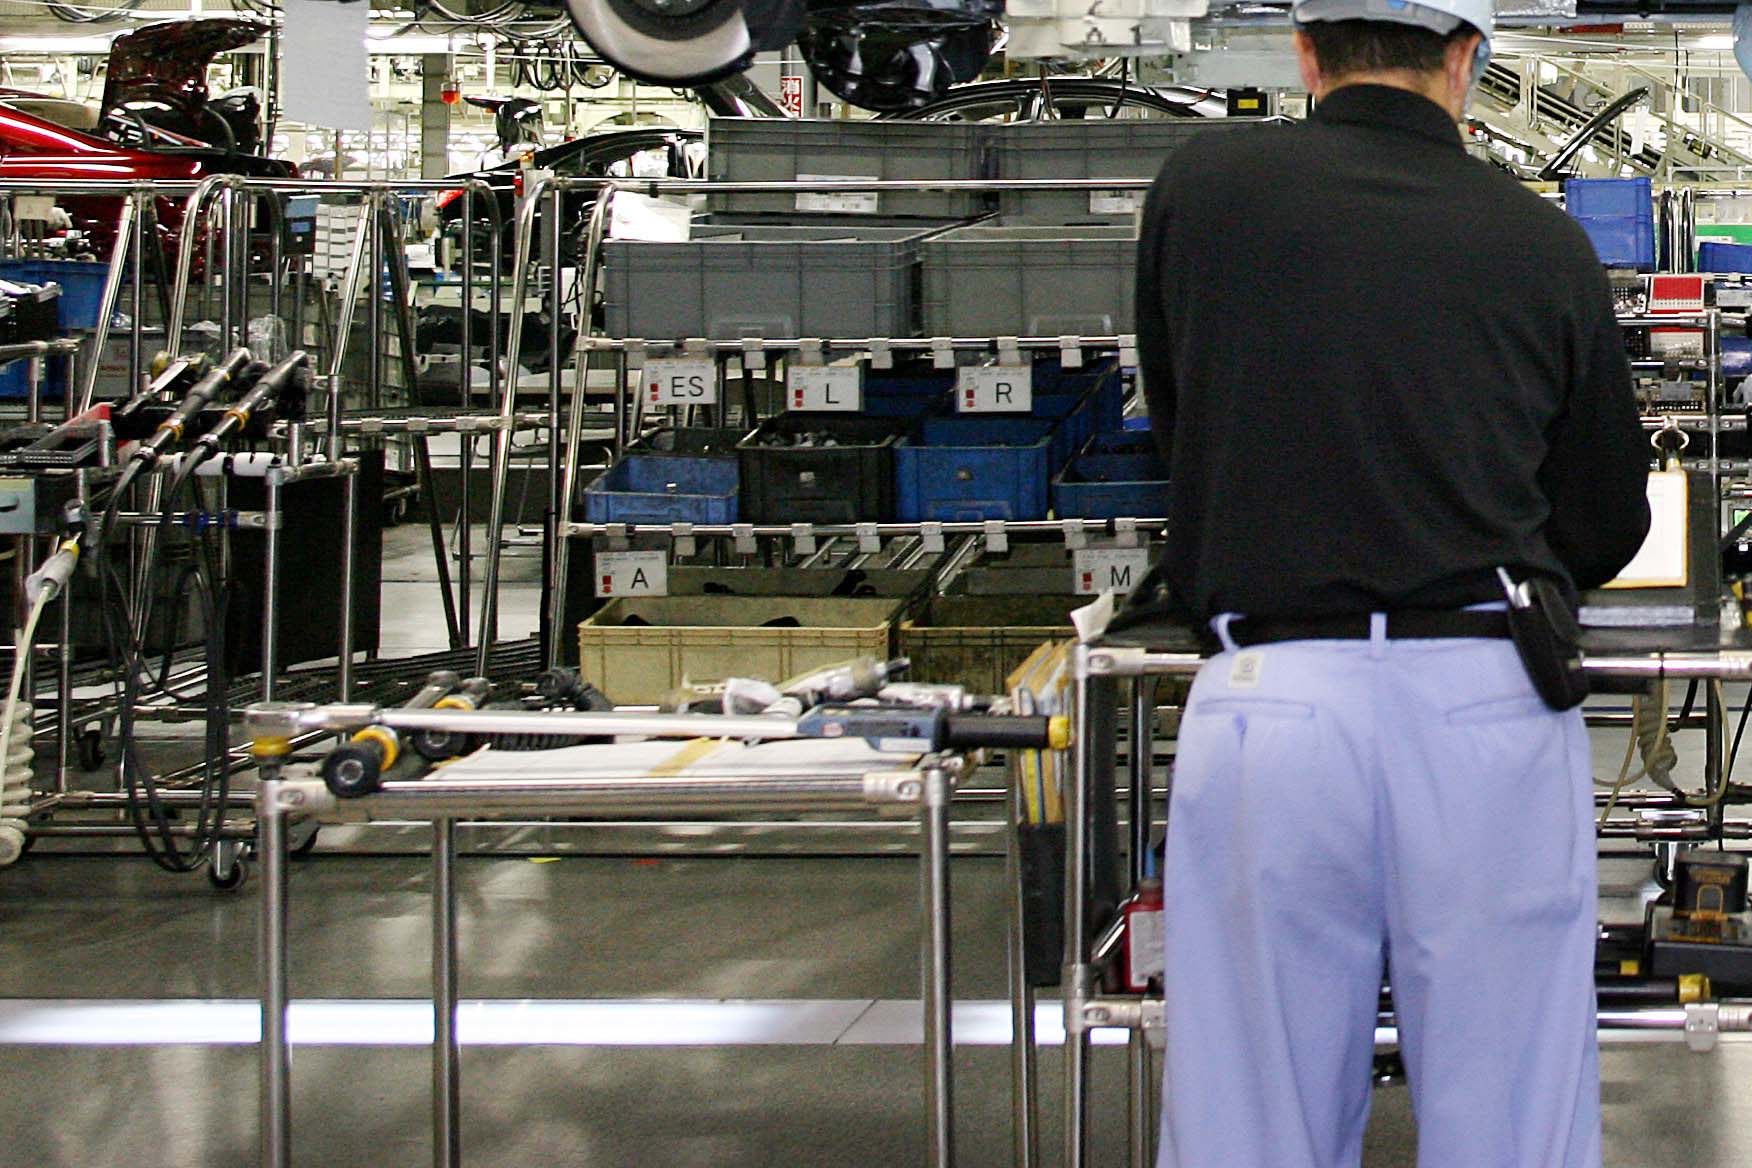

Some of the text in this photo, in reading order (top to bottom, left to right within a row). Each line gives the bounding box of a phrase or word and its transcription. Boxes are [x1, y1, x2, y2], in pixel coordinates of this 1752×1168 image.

[671, 376, 705, 398] ES
[825, 383, 840, 404] L
[996, 383, 1013, 404] R
[631, 567, 649, 589] A
[1111, 565, 1130, 587] M
